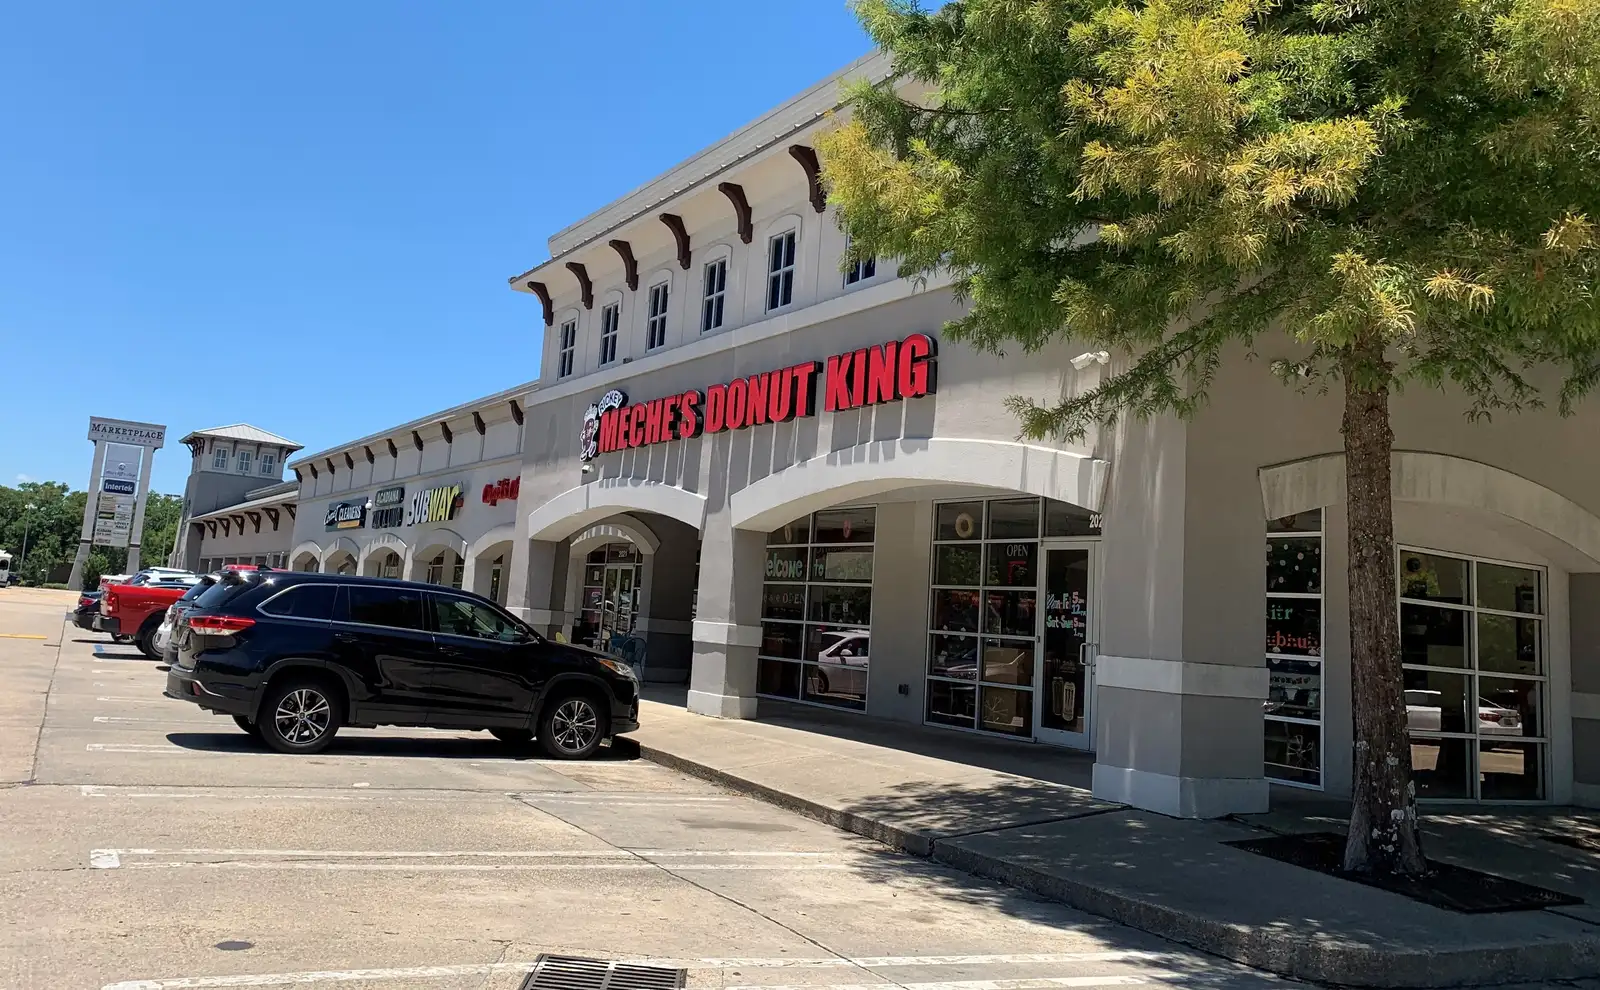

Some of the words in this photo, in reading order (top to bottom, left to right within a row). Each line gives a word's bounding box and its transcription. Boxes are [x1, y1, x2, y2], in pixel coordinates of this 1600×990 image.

[600, 390, 700, 453] MECHE'S
[704, 361, 818, 433] DONUT
[825, 333, 932, 412] KING
[92, 424, 163, 440] MARKETPLACE
[105, 482, 133, 492] Intertek
[407, 484, 461, 524] SUBWAY
[338, 505, 362, 521] CLEANERS
[1006, 544, 1029, 557] OPEN
[766, 552, 803, 578] elcome
